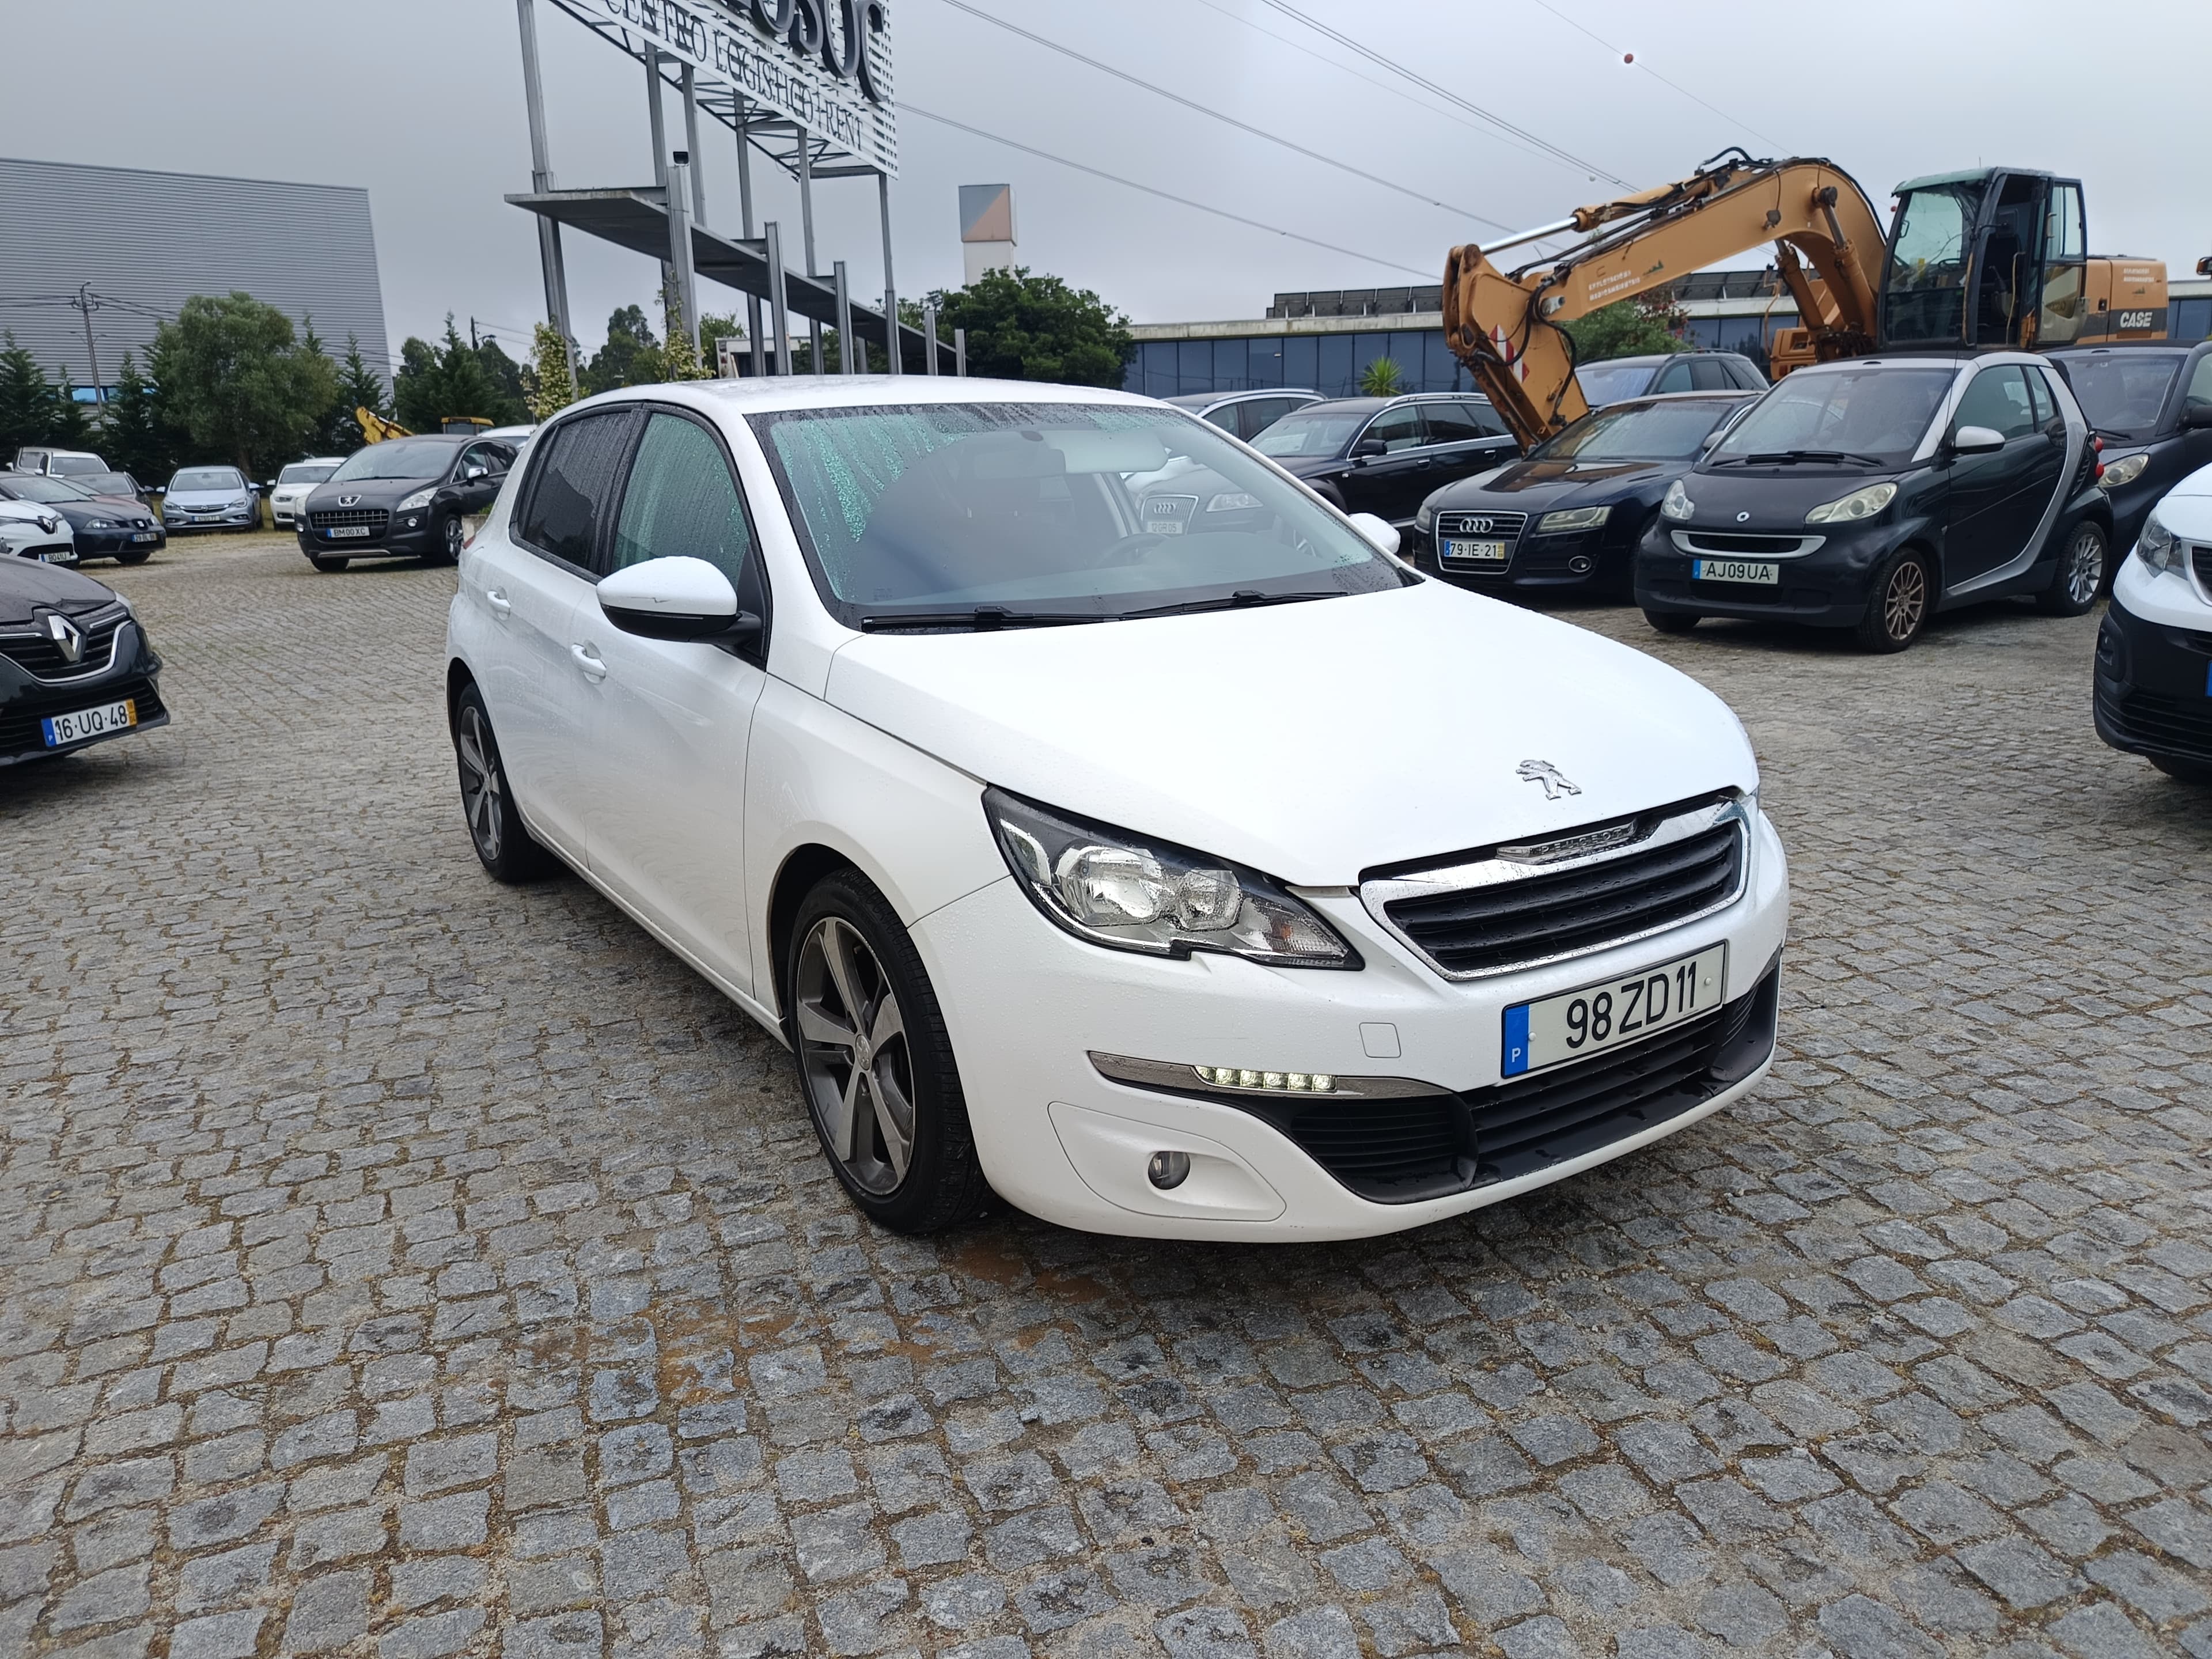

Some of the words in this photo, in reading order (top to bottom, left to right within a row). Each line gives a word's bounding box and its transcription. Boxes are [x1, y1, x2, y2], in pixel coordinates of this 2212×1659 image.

[2120, 312, 2153, 328] CASE
[1706, 562, 1770, 581] AJ09UA
[1540, 828, 1623, 855] PEUGEOT
[1512, 1047, 1521, 1063] P
[1566, 960, 1698, 1049] 98ZD11
